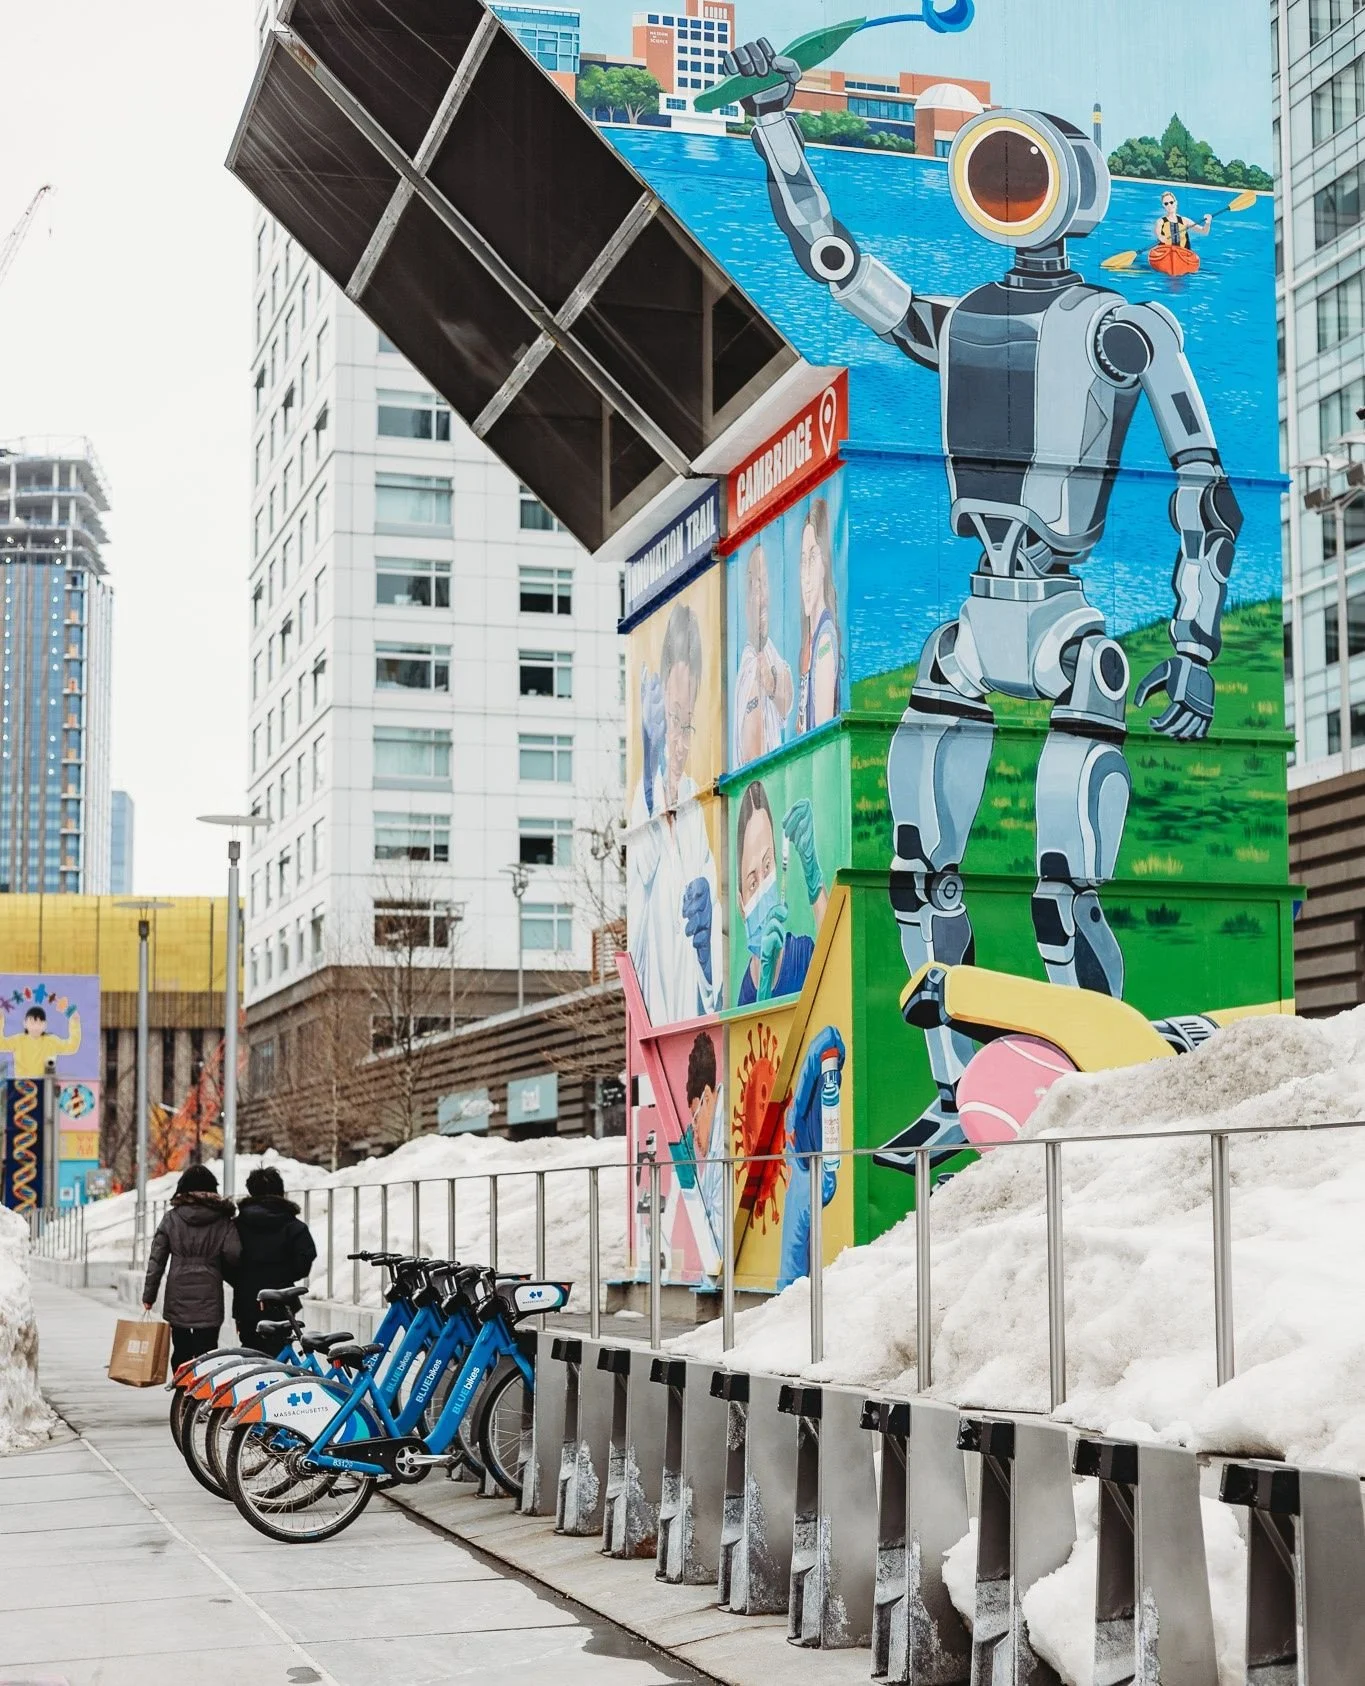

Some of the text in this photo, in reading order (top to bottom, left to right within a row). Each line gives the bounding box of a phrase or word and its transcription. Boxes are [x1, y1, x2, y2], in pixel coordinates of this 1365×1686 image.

[736, 414, 813, 519] CAMBRIDGE
[626, 495, 716, 603] INNOVATION TRAIL
[386, 1351, 412, 1393] BLUEbikes
[415, 1359, 442, 1404] BLUEbikes
[451, 1366, 480, 1416] BLUEbikes
[273, 1406, 329, 1418] MASSACHUSETTS
